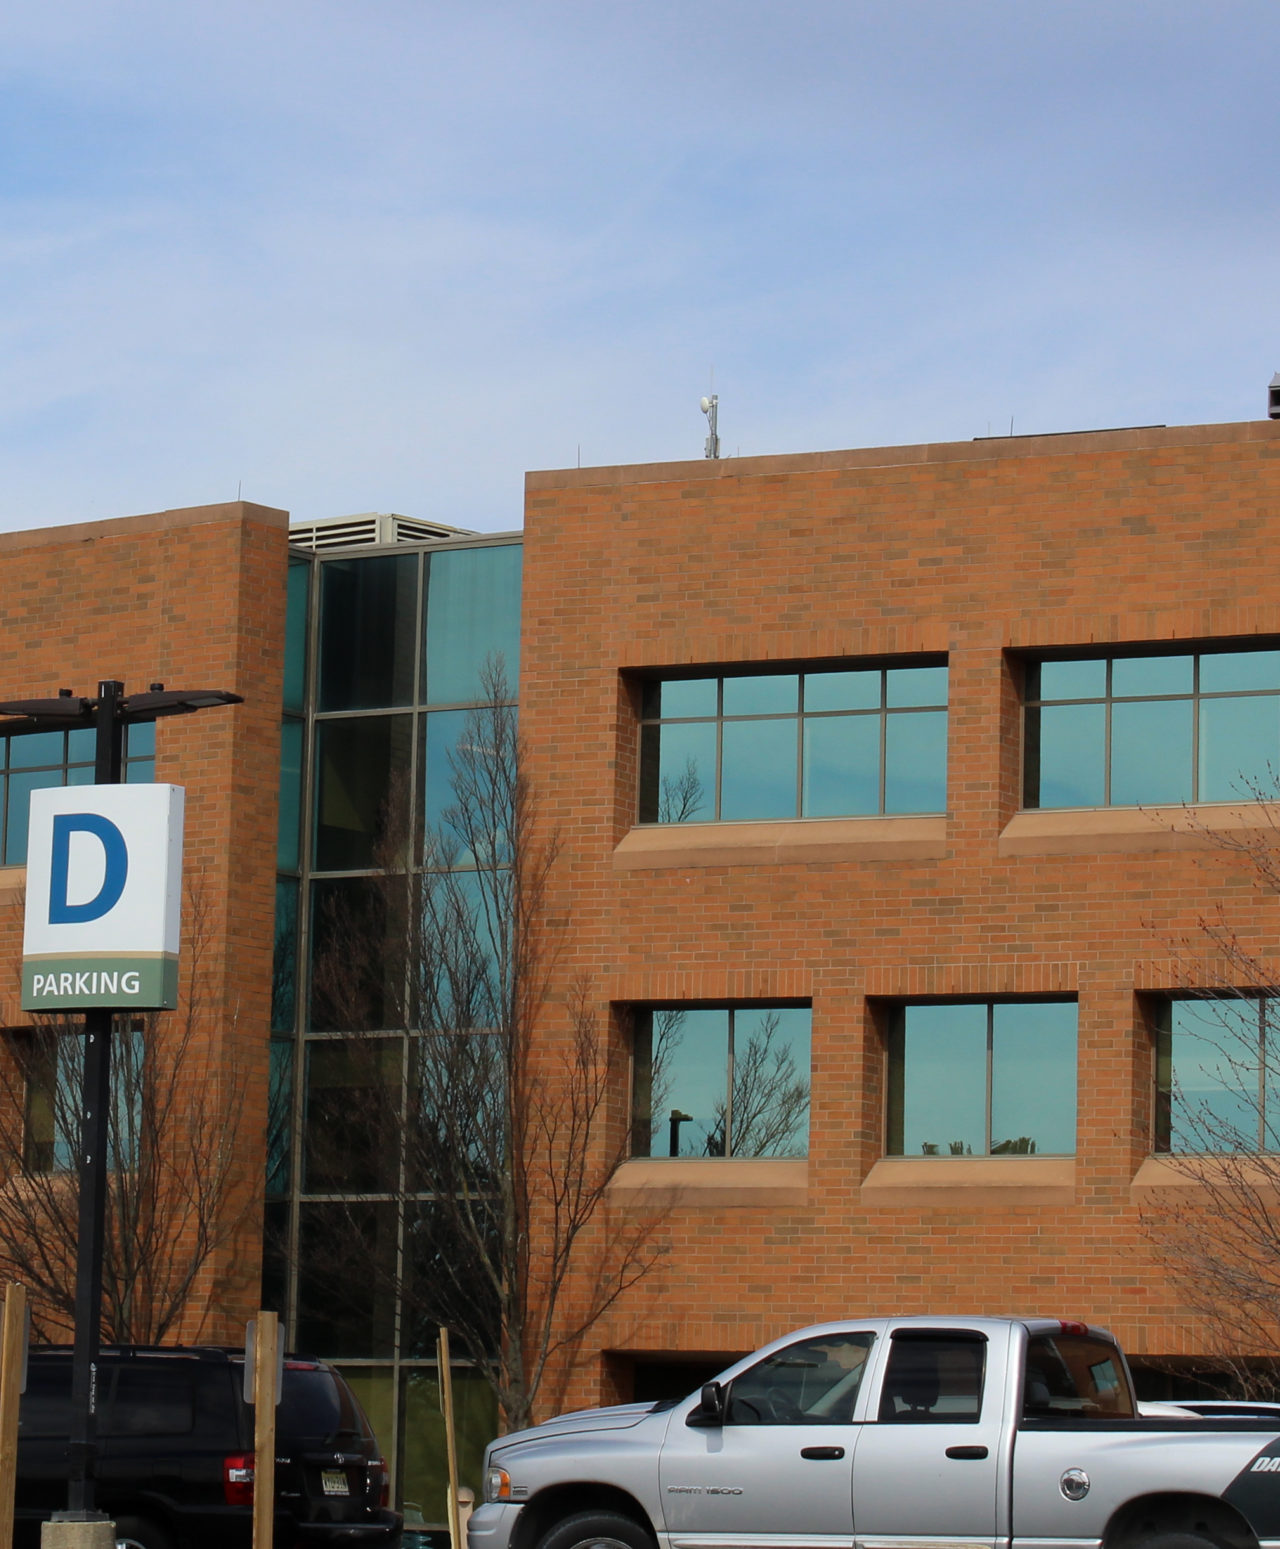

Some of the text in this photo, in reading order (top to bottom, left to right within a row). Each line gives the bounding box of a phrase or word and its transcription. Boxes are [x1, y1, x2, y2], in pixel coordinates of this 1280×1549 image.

[48, 812, 129, 924] D
[32, 971, 140, 997] PARKING
[705, 1486, 744, 1495] 1500
